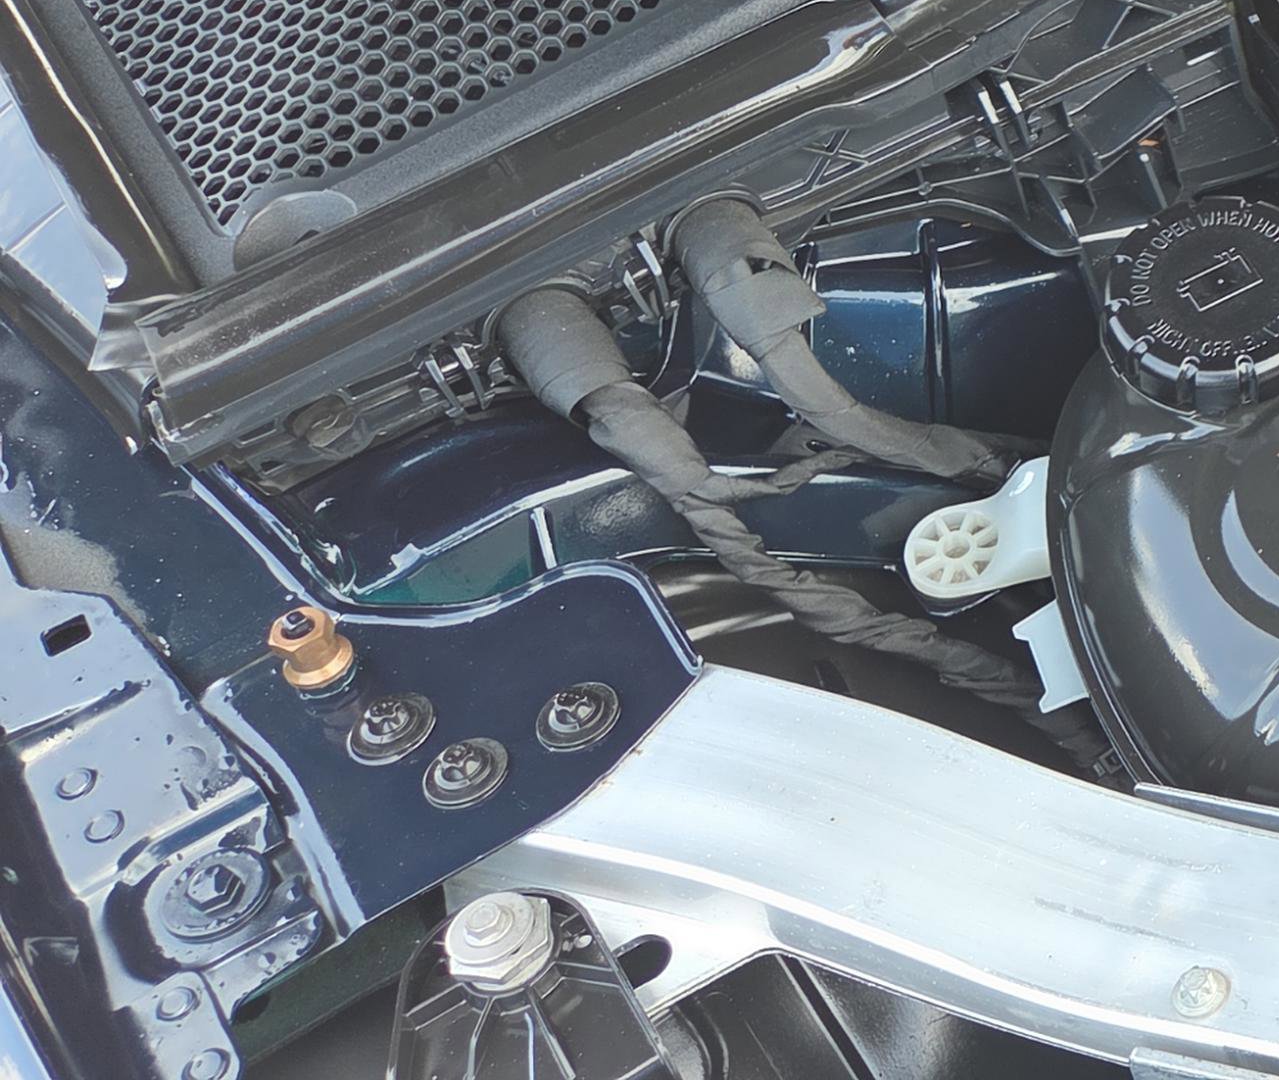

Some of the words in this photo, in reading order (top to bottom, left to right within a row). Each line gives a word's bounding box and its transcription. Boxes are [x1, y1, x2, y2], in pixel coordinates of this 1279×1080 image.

[1197, 211, 1253, 227] WHEN
[1151, 219, 1196, 250] OPEN
[1131, 248, 1158, 281] NOT
[1130, 284, 1152, 306] DO
